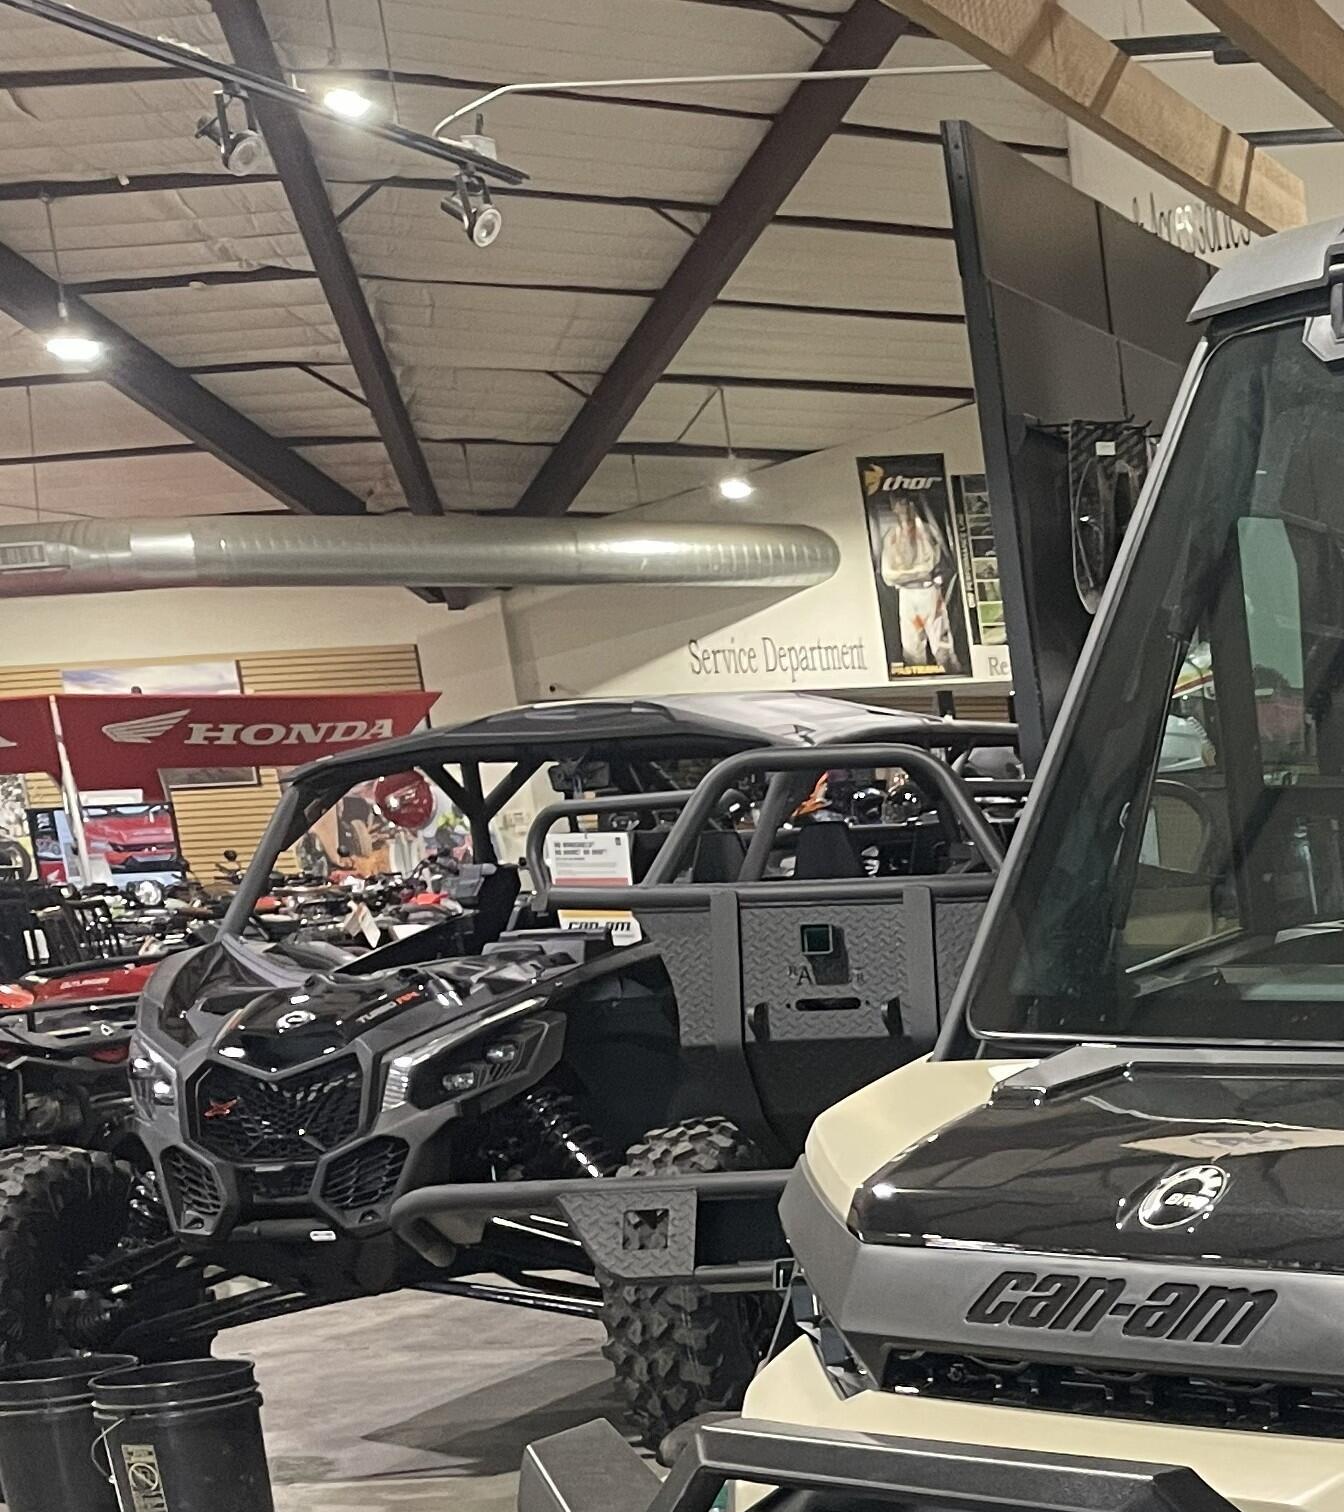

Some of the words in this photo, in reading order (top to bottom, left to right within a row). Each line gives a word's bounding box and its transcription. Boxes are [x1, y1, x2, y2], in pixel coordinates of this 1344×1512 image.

[882, 475, 942, 491] thor
[687, 638, 759, 676] Service
[761, 636, 868, 683] Department
[183, 717, 394, 747] HONDA
[1165, 1192, 1210, 1210] BRP
[965, 1269, 1278, 1346] can-am
